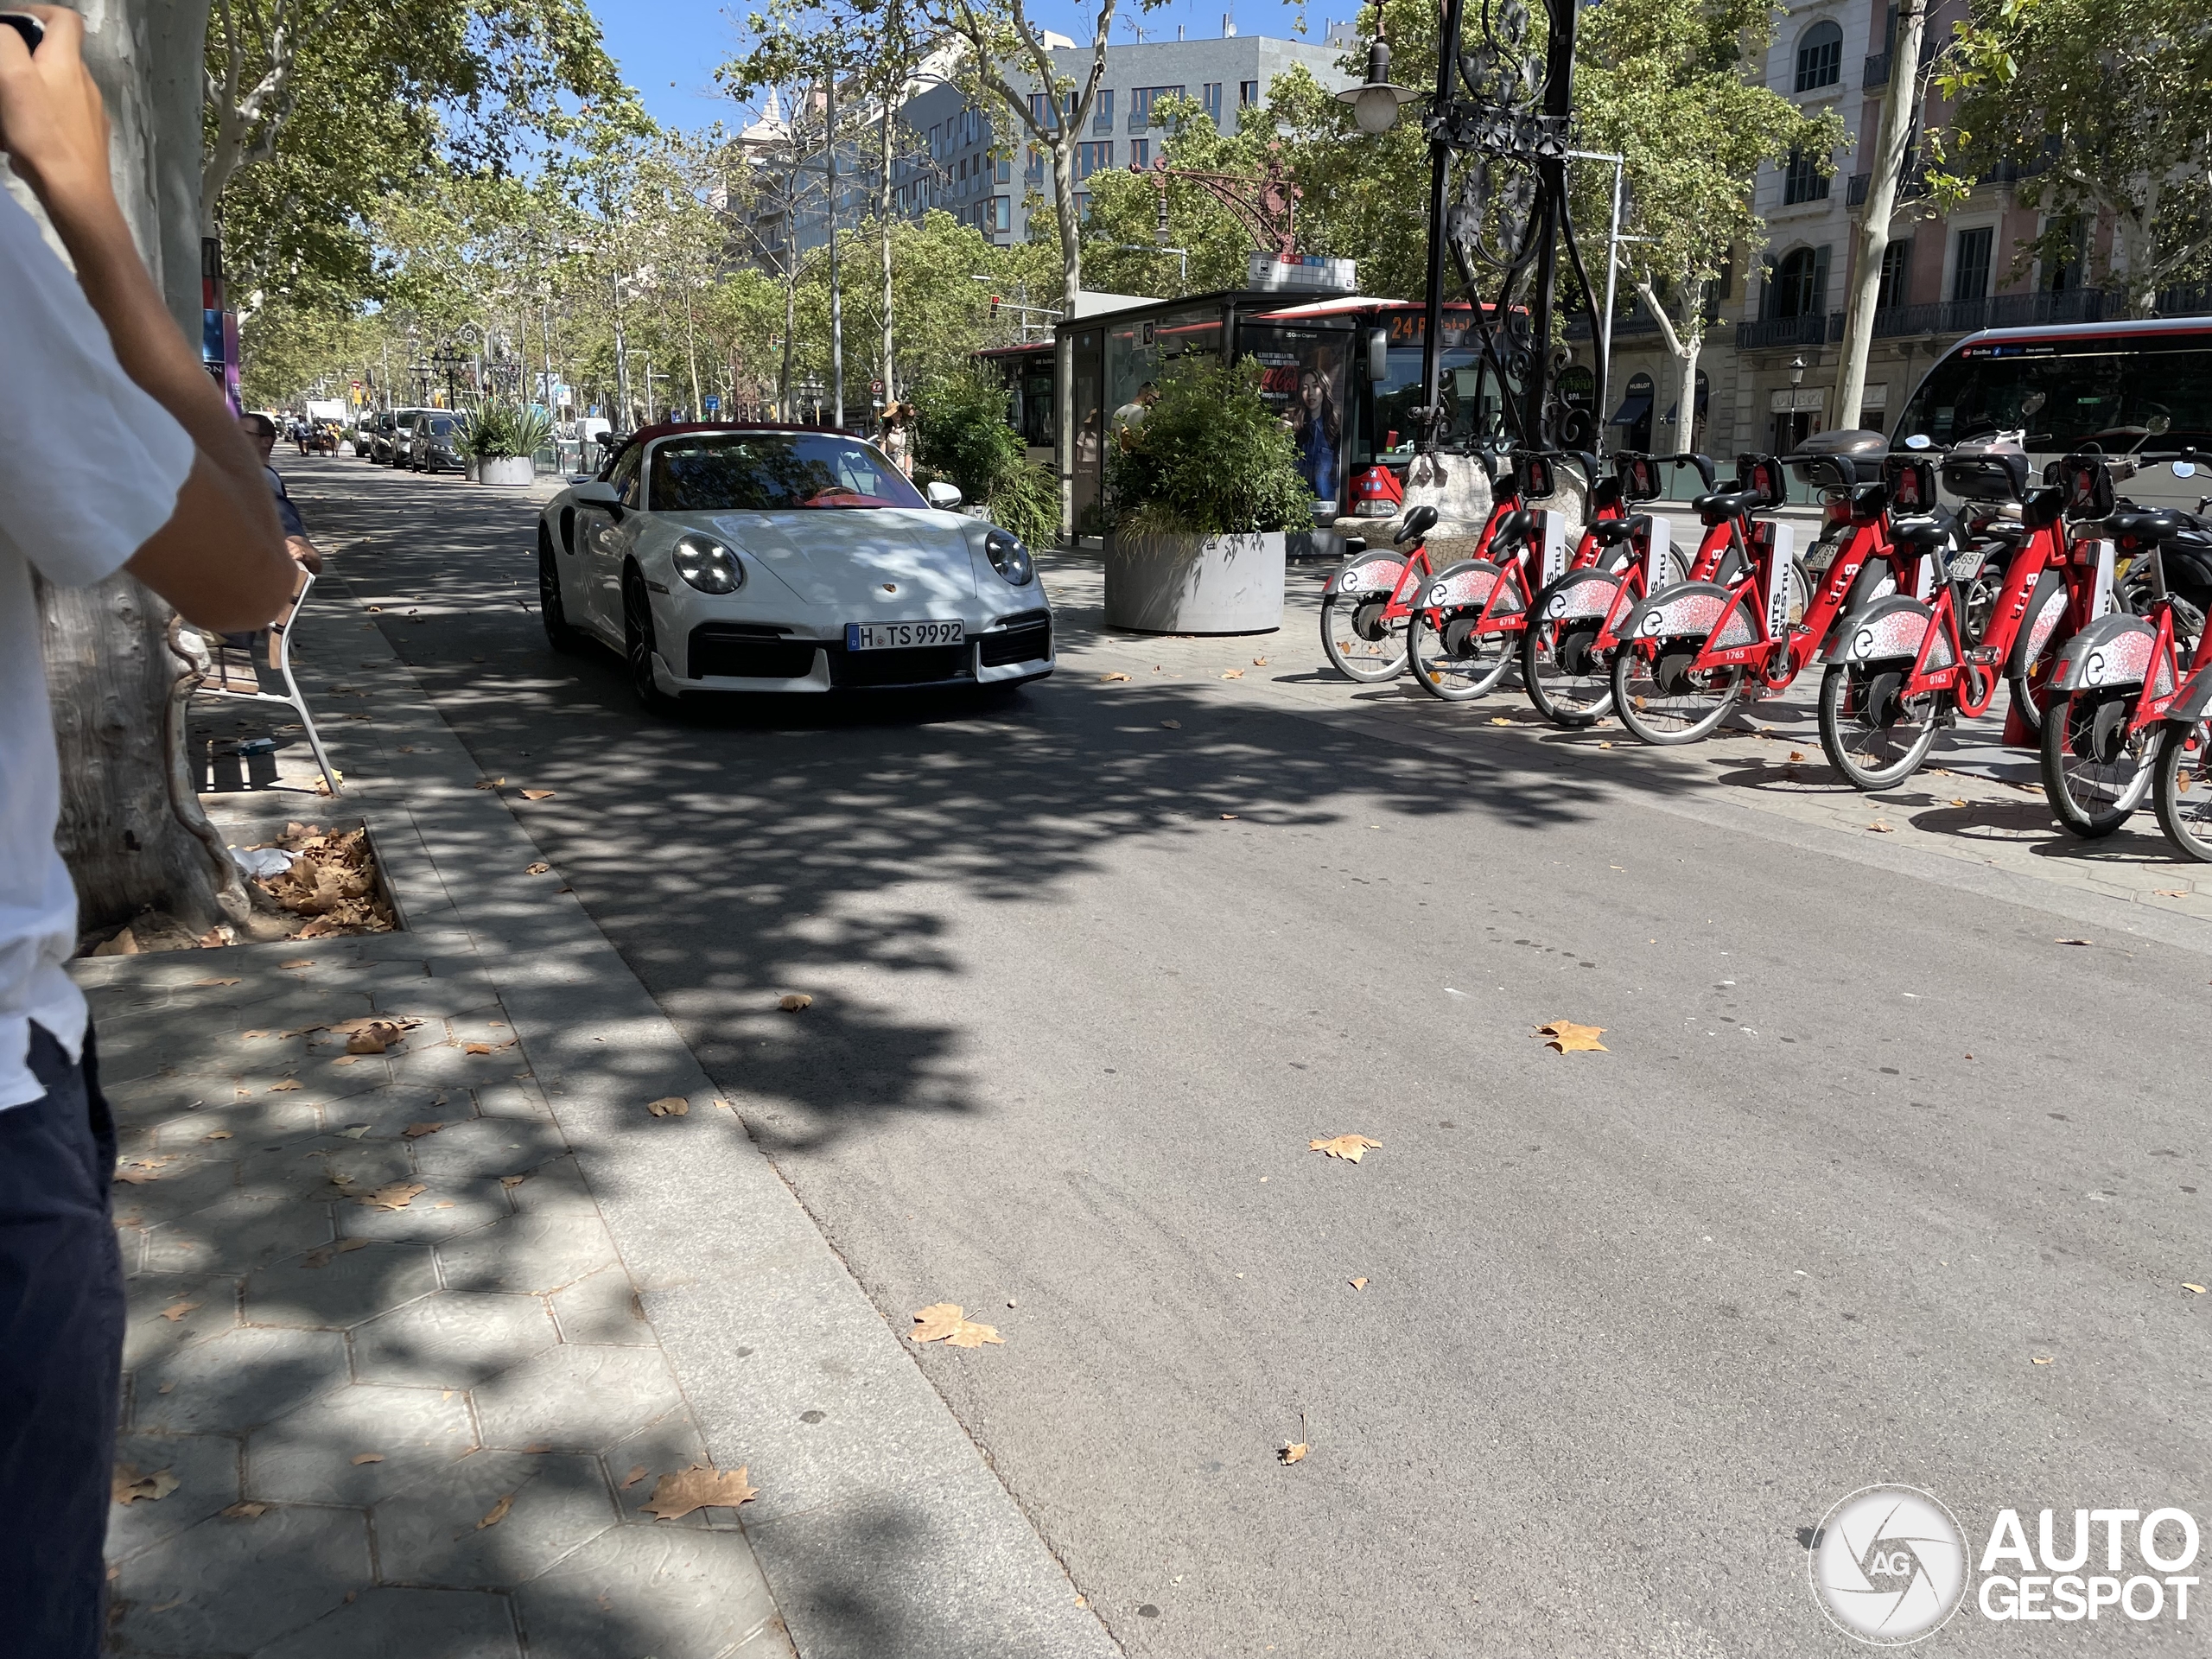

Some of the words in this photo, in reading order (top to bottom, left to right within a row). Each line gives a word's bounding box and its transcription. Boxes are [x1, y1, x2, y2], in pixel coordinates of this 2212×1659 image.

[1391, 316, 1413, 340] 24
[1950, 564, 1967, 576] KLL
[1824, 563, 1860, 607] bicing
[2010, 573, 2039, 620] bicing
[1499, 617, 1516, 626] 6718
[1771, 592, 1781, 639] NITS
[861, 627, 874, 647] H
[887, 625, 912, 645] TS
[916, 623, 963, 645] 9992
[1726, 650, 1745, 660] 1765
[1929, 673, 1947, 685] 0162
[2153, 700, 2170, 715] 5896
